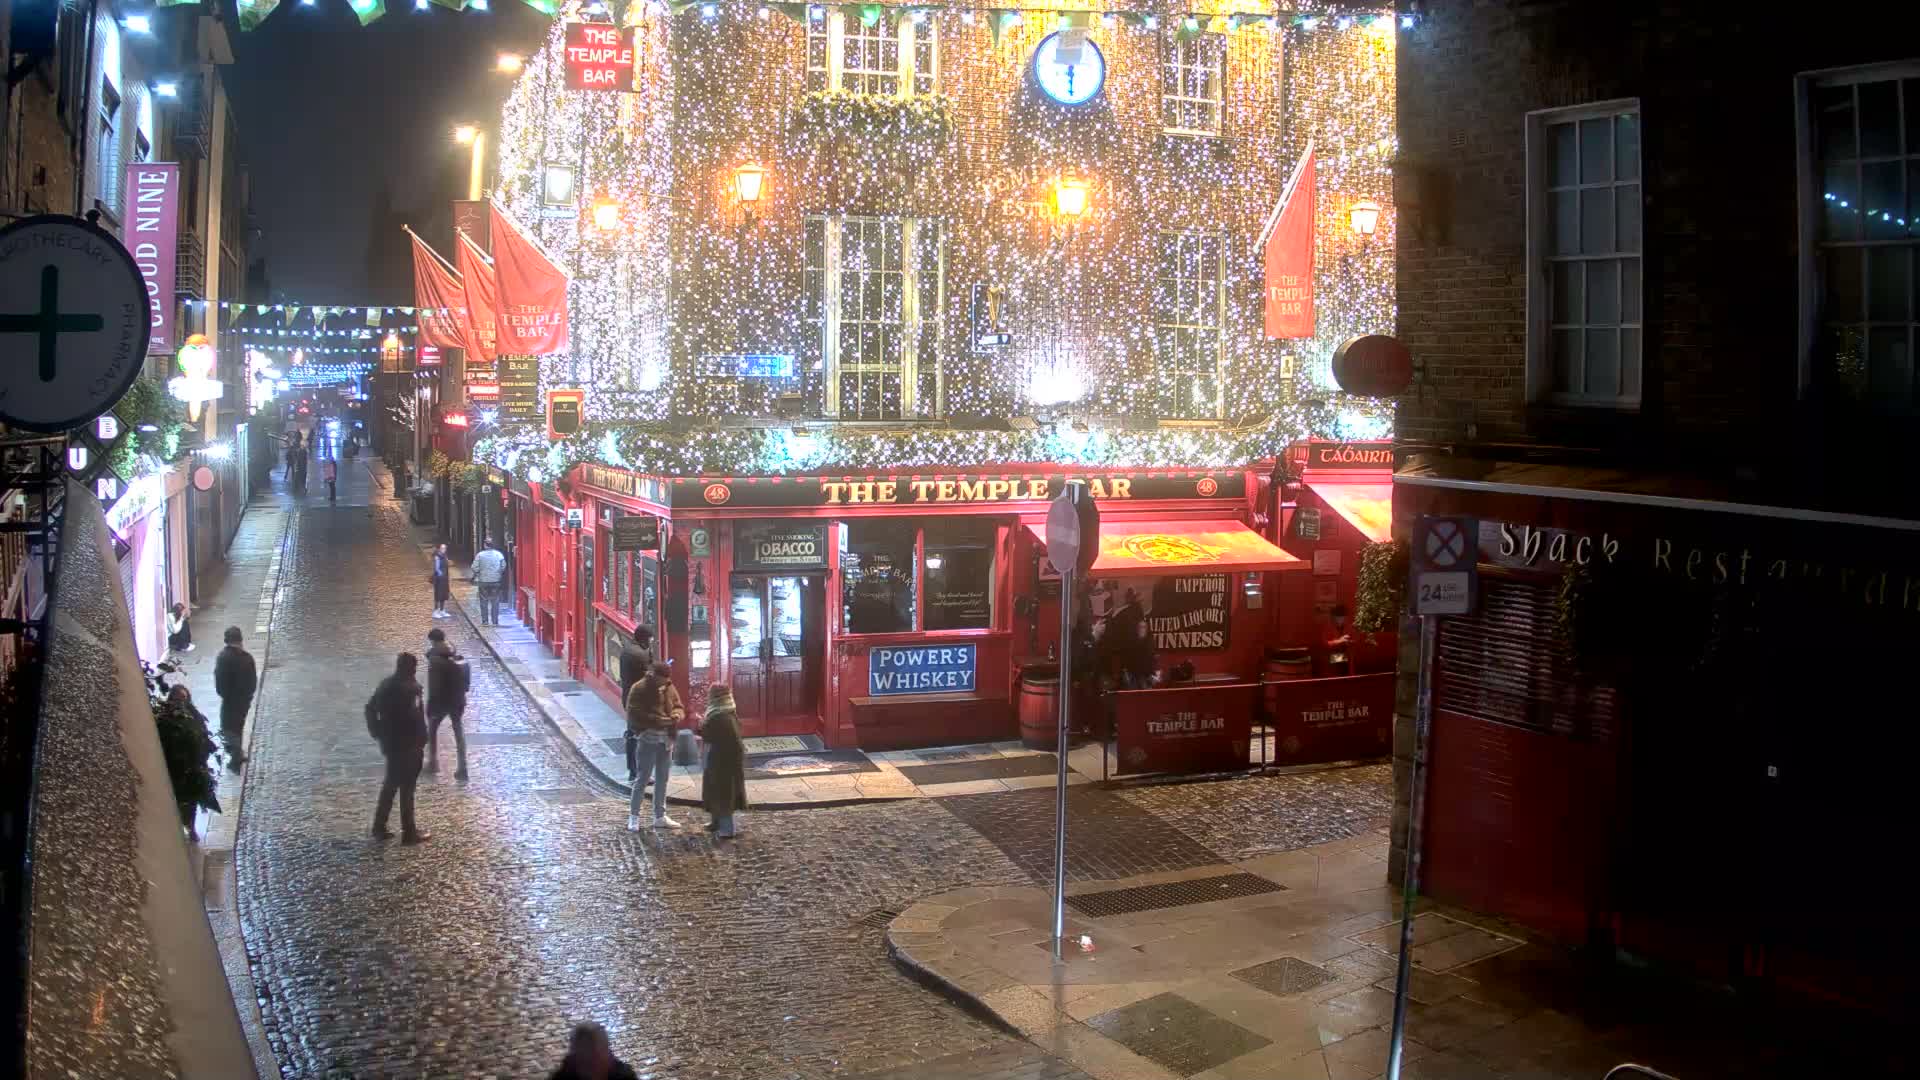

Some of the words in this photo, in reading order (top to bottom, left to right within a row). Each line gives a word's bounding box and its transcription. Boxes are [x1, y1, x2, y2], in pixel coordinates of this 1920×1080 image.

[583, 28, 617, 45] THE
[567, 47, 633, 64] TEMPLE
[583, 69, 617, 84] BAR
[136, 171, 169, 232] NINE
[519, 304, 545, 313] THE
[1281, 303, 1303, 315] BAR
[502, 312, 564, 326] TEMPLE
[516, 327, 549, 338] BAR
[592, 467, 606, 488] THE
[606, 471, 633, 495] TEMPLE
[709, 486, 726, 500] 48
[822, 481, 898, 503] THE
[911, 479, 1050, 502] TEMPLE
[1065, 478, 1132, 498] AR
[752, 539, 815, 561] TOBACCO
[1499, 522, 1619, 565] Shack
[893, 568, 912, 586] BAR
[1175, 577, 1226, 593] EMPEROR
[1211, 593, 1225, 607] OF
[1421, 583, 1441, 601] 24
[1152, 630, 1224, 648] INNESS
[879, 648, 968, 667] POWER'S
[873, 670, 973, 690] WHISKEY
[1177, 712, 1197, 720] THE
[1302, 710, 1345, 722] TEMPLE
[1348, 706, 1369, 717] BAR
[1146, 721, 1197, 733] TEMPLE
[1200, 718, 1225, 729] BAR
